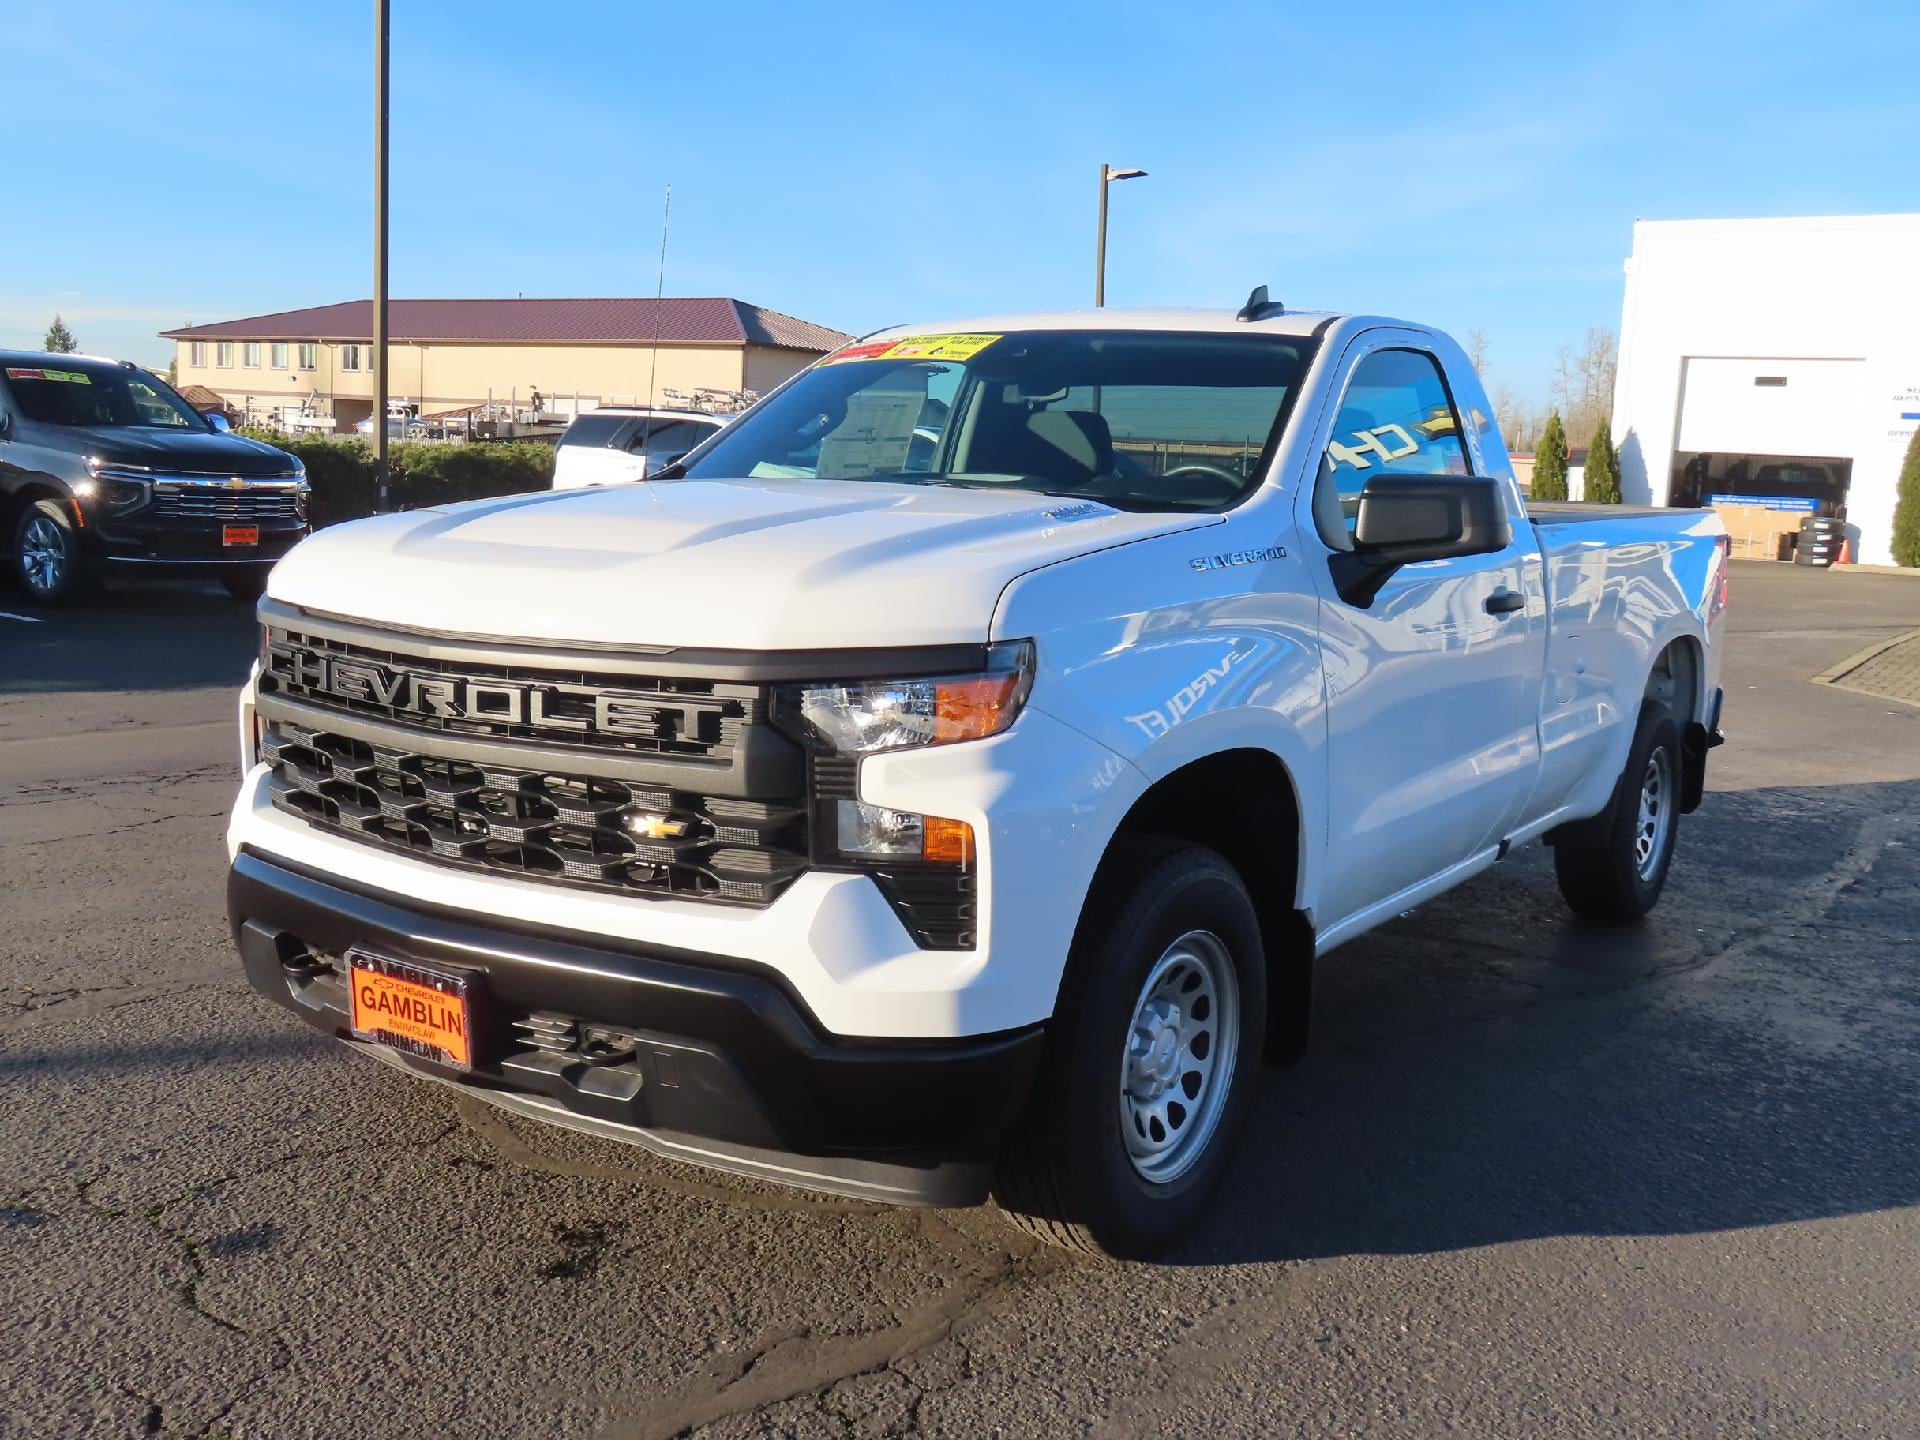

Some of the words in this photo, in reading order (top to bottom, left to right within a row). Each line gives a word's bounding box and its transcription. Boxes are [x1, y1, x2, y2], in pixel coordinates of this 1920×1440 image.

[1190, 546, 1287, 573] SILVERADO
[267, 646, 738, 740] CHEVROLET
[395, 983, 445, 1004] CHEVROLET
[361, 986, 463, 1037] GAMBLIN
[388, 1018, 436, 1040] ENUMCLAW
